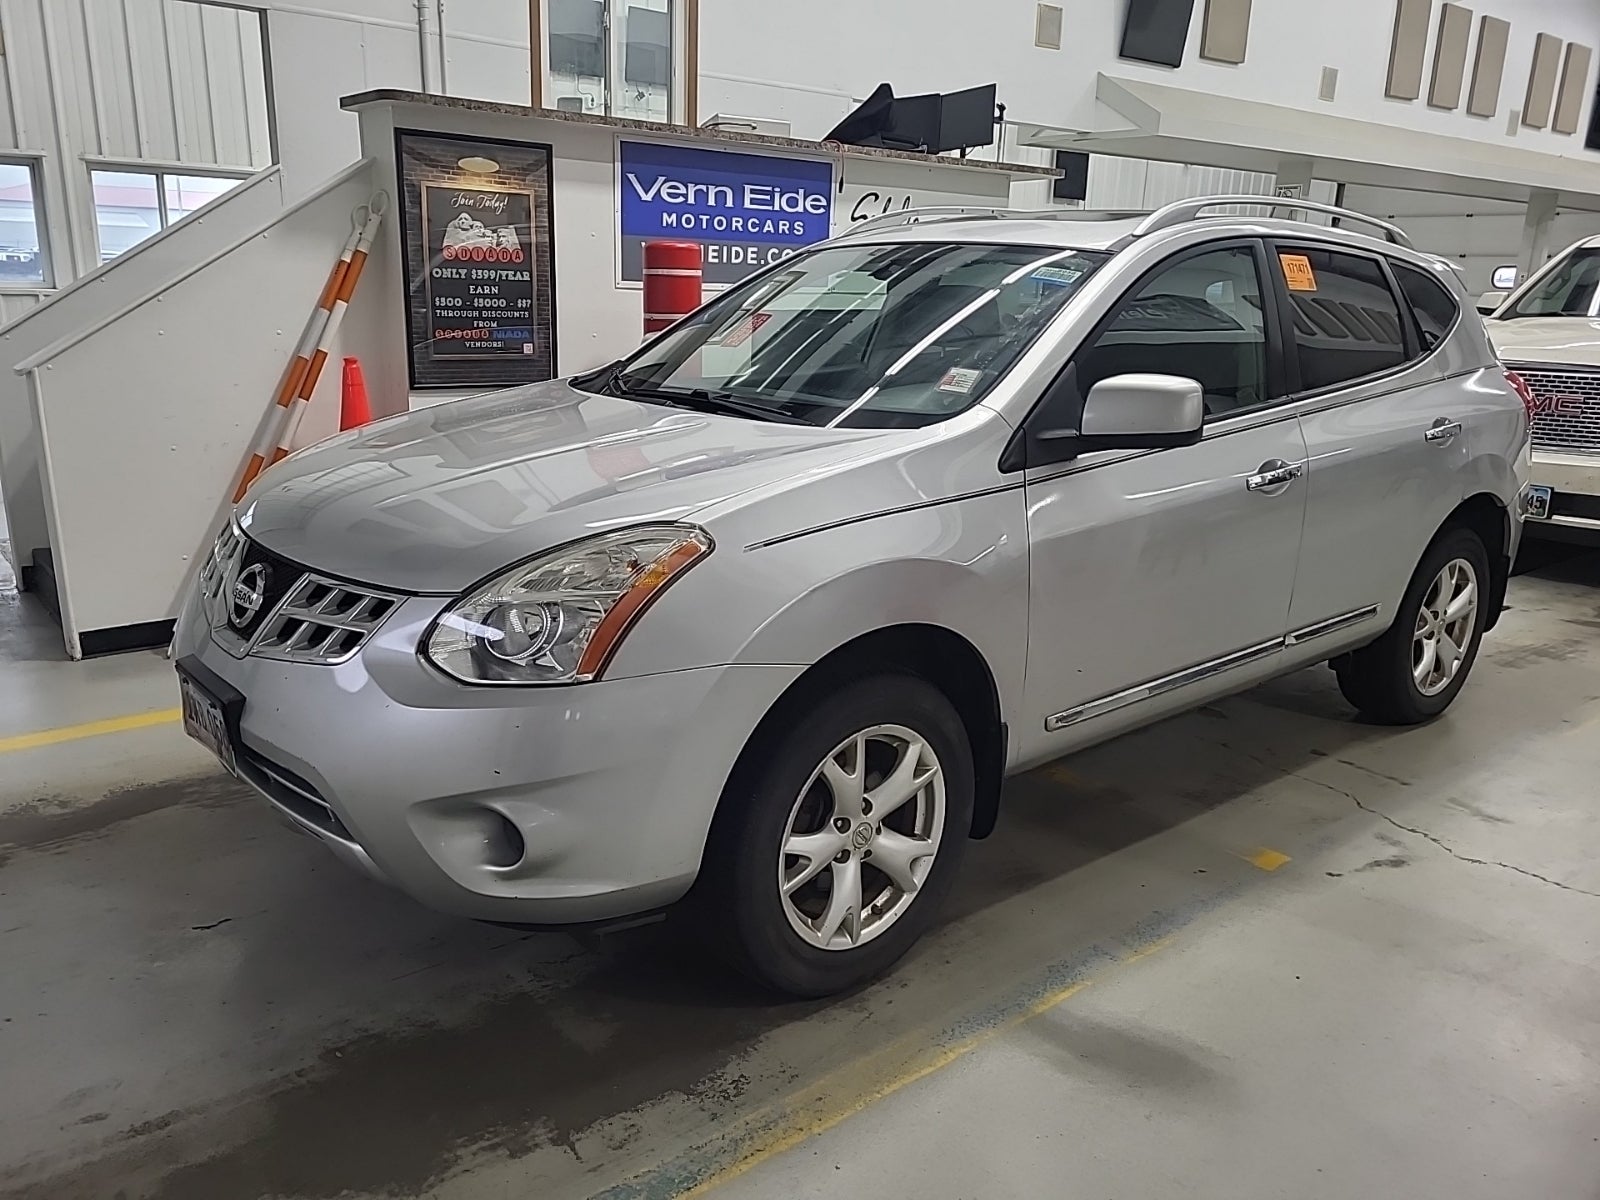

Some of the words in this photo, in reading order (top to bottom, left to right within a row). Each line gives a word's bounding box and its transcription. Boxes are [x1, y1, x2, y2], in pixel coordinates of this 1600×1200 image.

[626, 173, 734, 208] Vern
[743, 184, 827, 215] Eide
[451, 192, 474, 208] Join
[476, 194, 509, 215] Today!
[662, 212, 805, 235] MOTORCARS
[444, 246, 522, 262] SDIADA
[432, 268, 467, 279] ONLY
[469, 285, 499, 294] EARN
[434, 296, 462, 306] $500
[473, 297, 507, 307] $5000
[435, 310, 479, 318] THROUGH
[482, 310, 529, 318] DISCOUNTS
[473, 320, 498, 328] FROM
[492, 330, 530, 338] NIADA
[1531, 393, 1584, 415] MC
